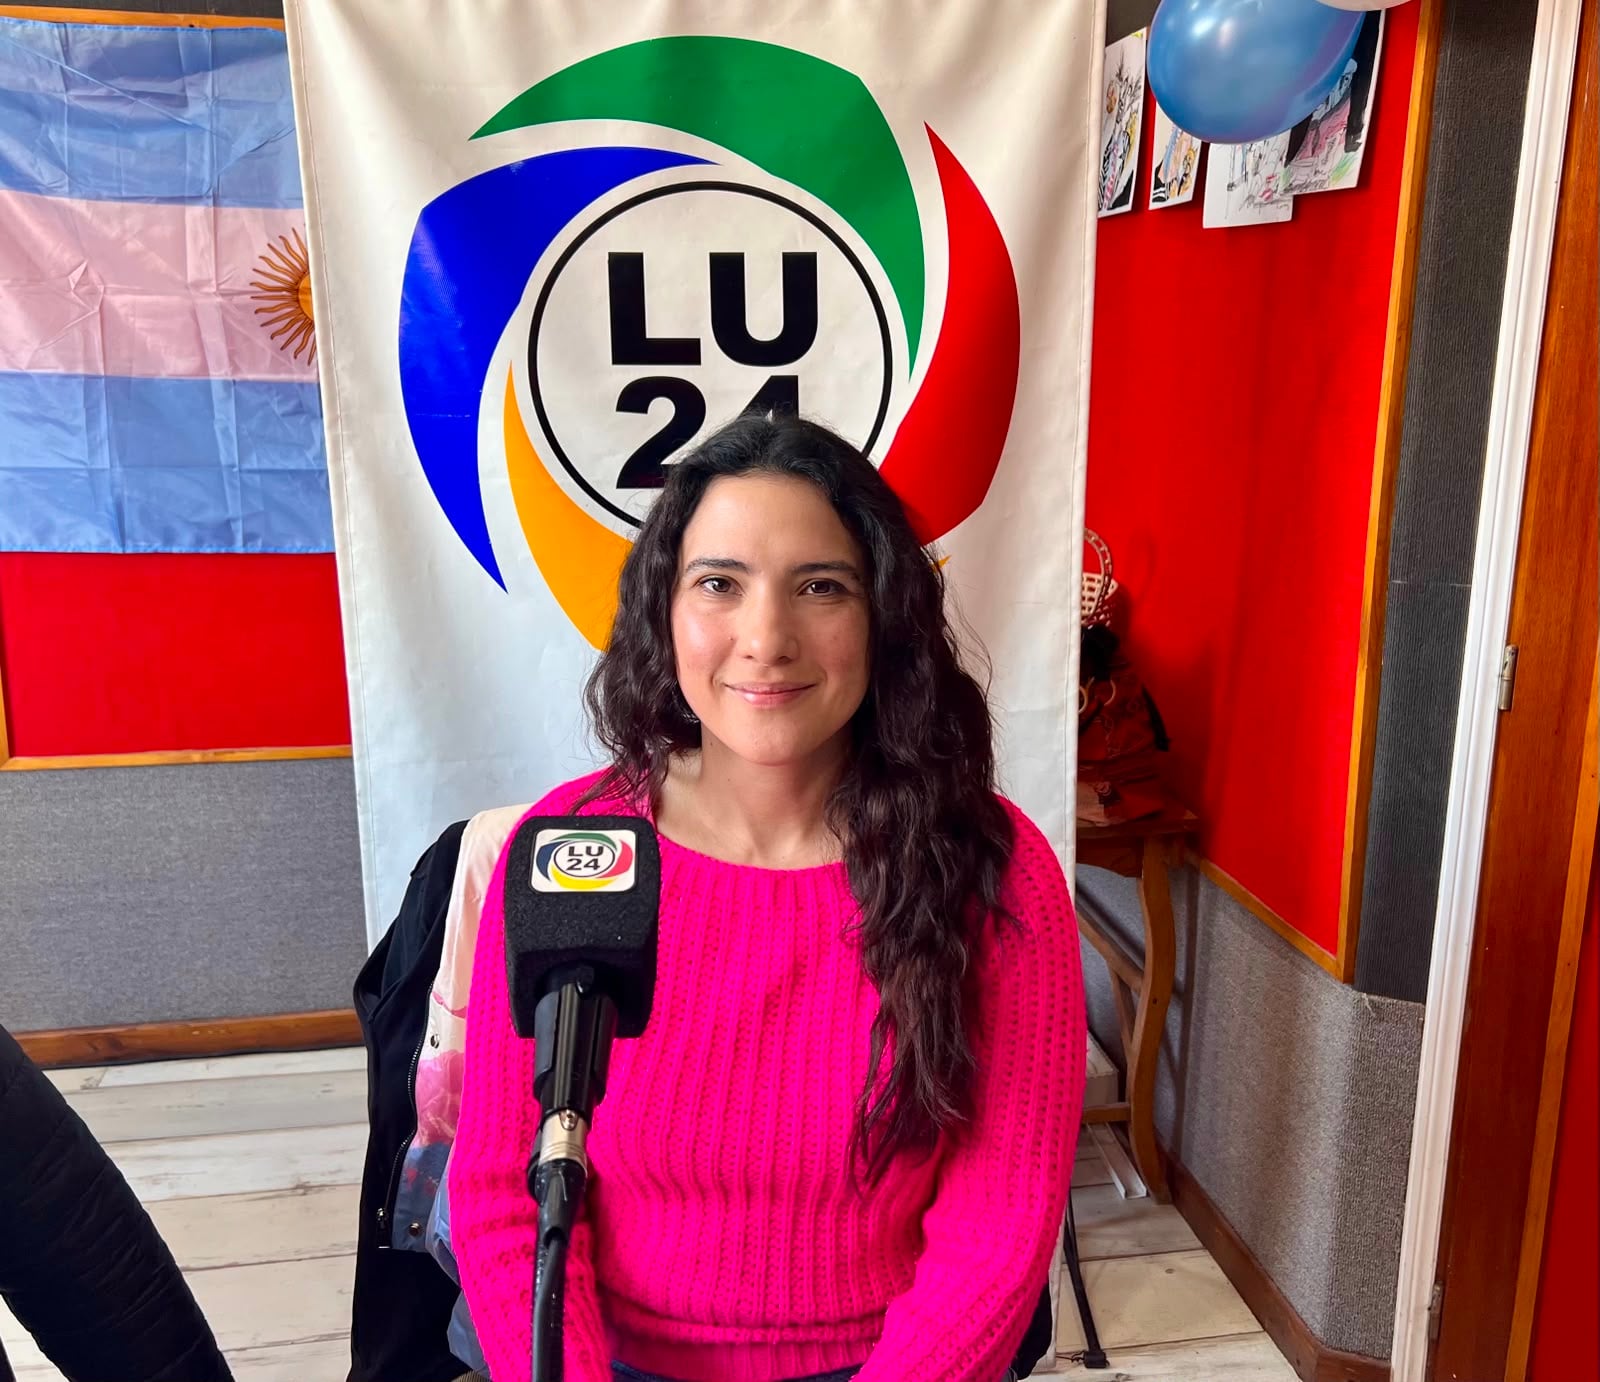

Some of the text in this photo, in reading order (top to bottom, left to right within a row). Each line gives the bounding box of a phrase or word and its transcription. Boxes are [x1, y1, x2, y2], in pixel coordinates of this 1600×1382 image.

[608, 252, 818, 367] LU
[568, 846, 604, 857] LU
[566, 858, 600, 871] 24
